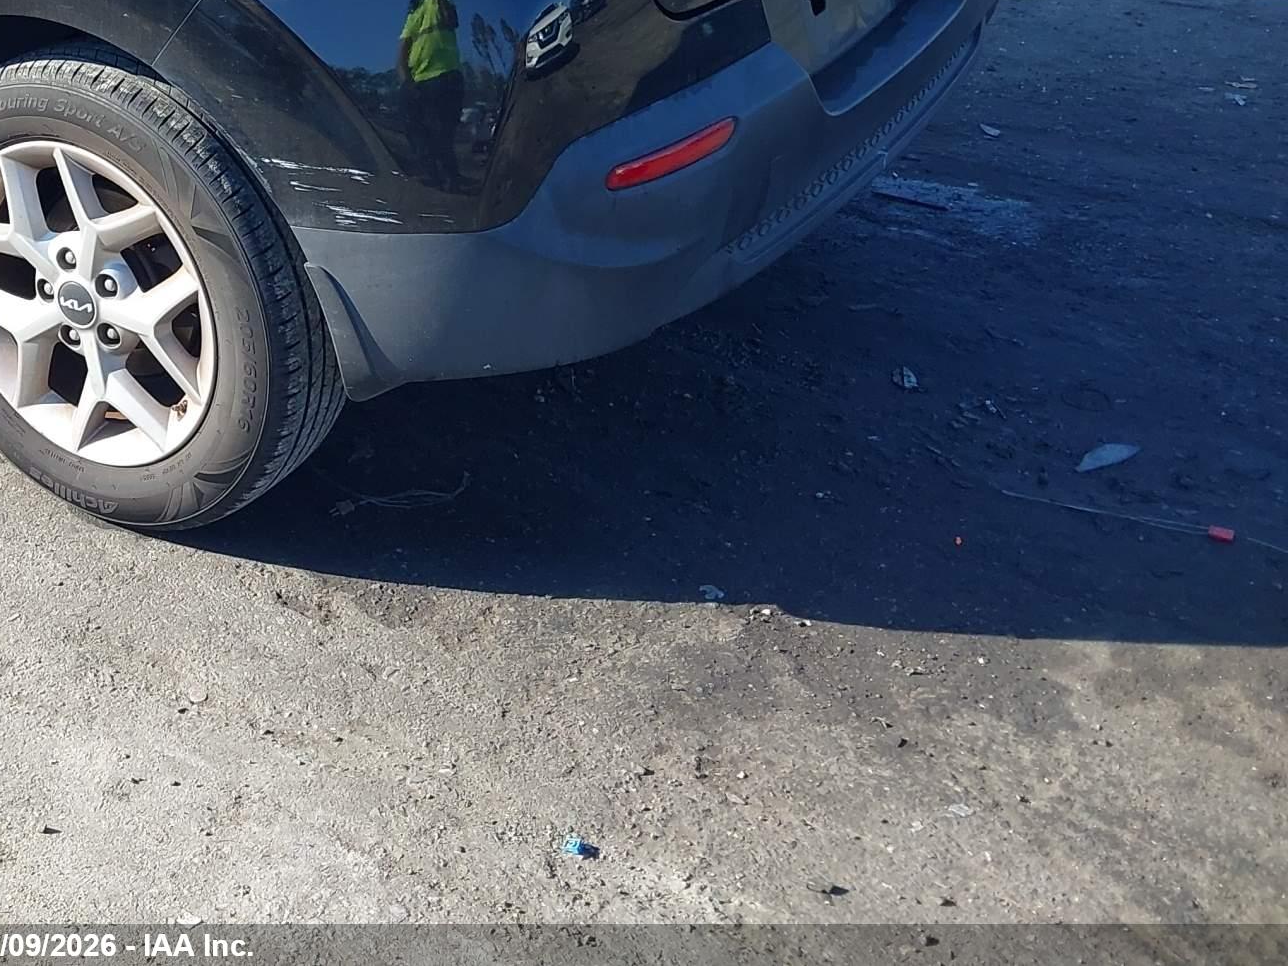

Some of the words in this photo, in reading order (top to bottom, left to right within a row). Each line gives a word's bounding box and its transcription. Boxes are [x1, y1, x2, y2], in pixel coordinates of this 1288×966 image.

[53, 98, 106, 128] Sport
[234, 305, 258, 434] 205/60R16
[28, 466, 120, 515] Achilles
